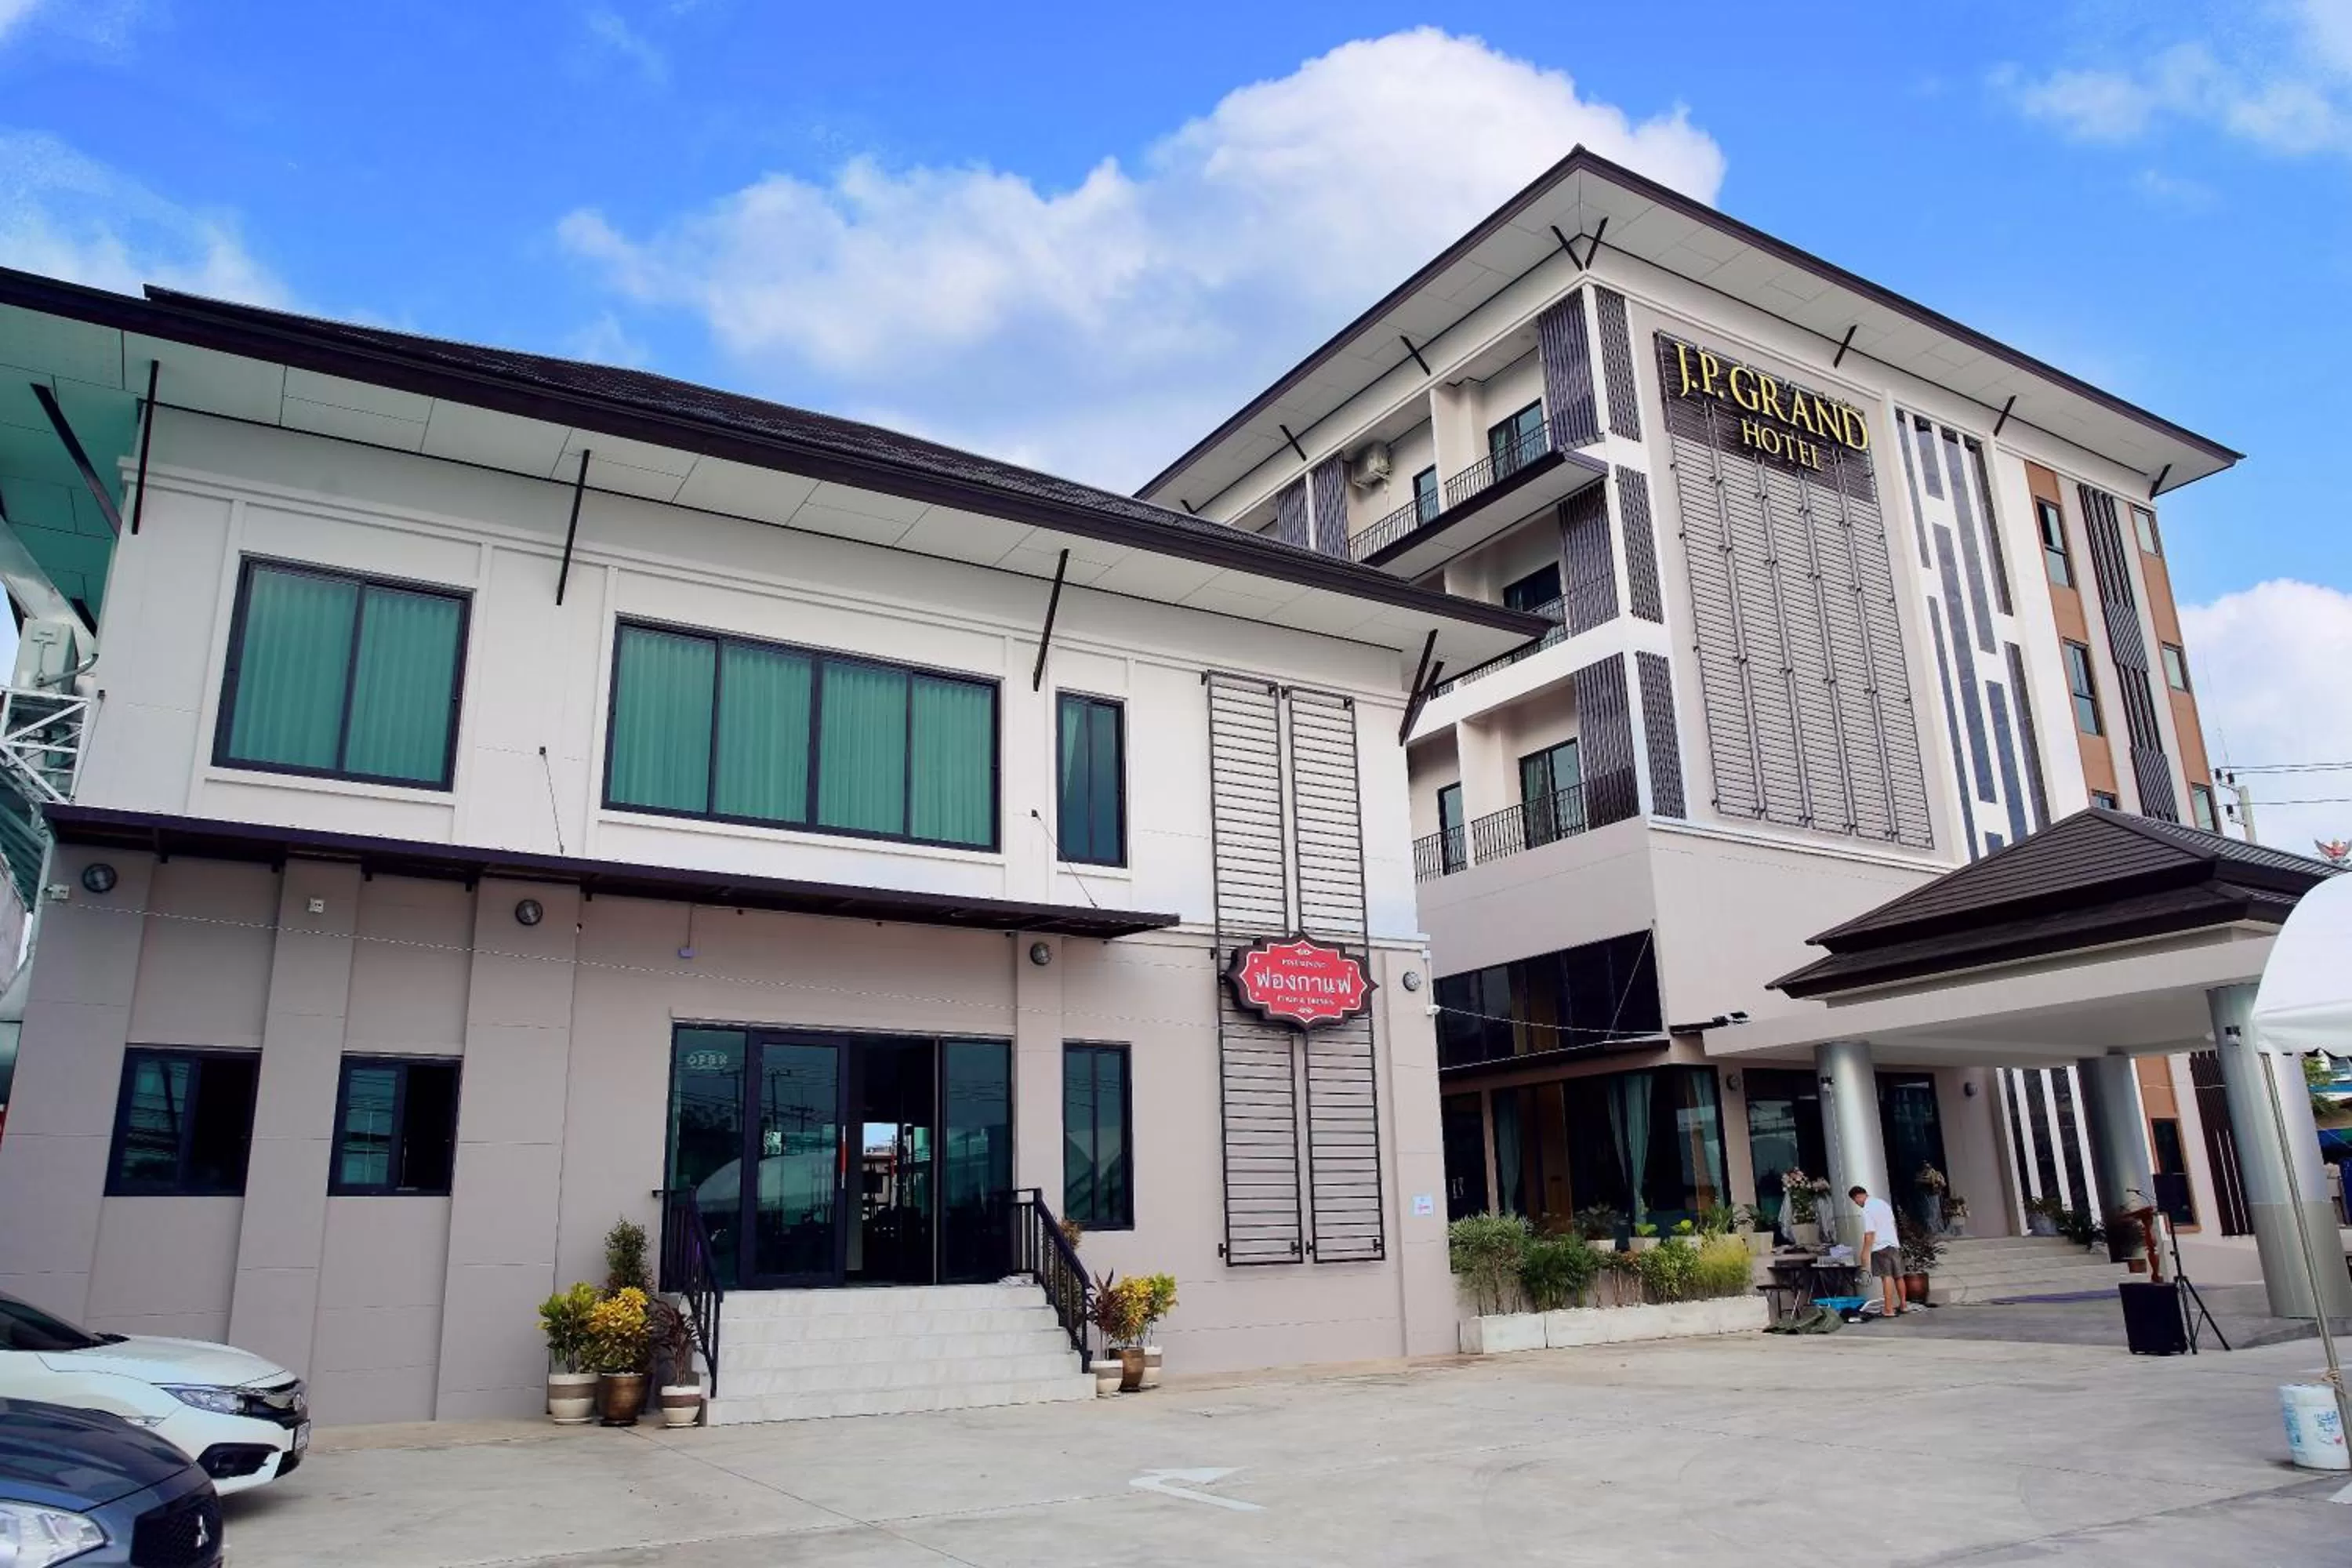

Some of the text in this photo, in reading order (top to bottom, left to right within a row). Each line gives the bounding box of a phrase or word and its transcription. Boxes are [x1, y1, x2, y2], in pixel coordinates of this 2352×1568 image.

[1675, 342, 1870, 452] J.P. GRAND
[1740, 418, 1825, 471] HOTEL
[1254, 966, 1352, 994] ฟองกาแฟ
